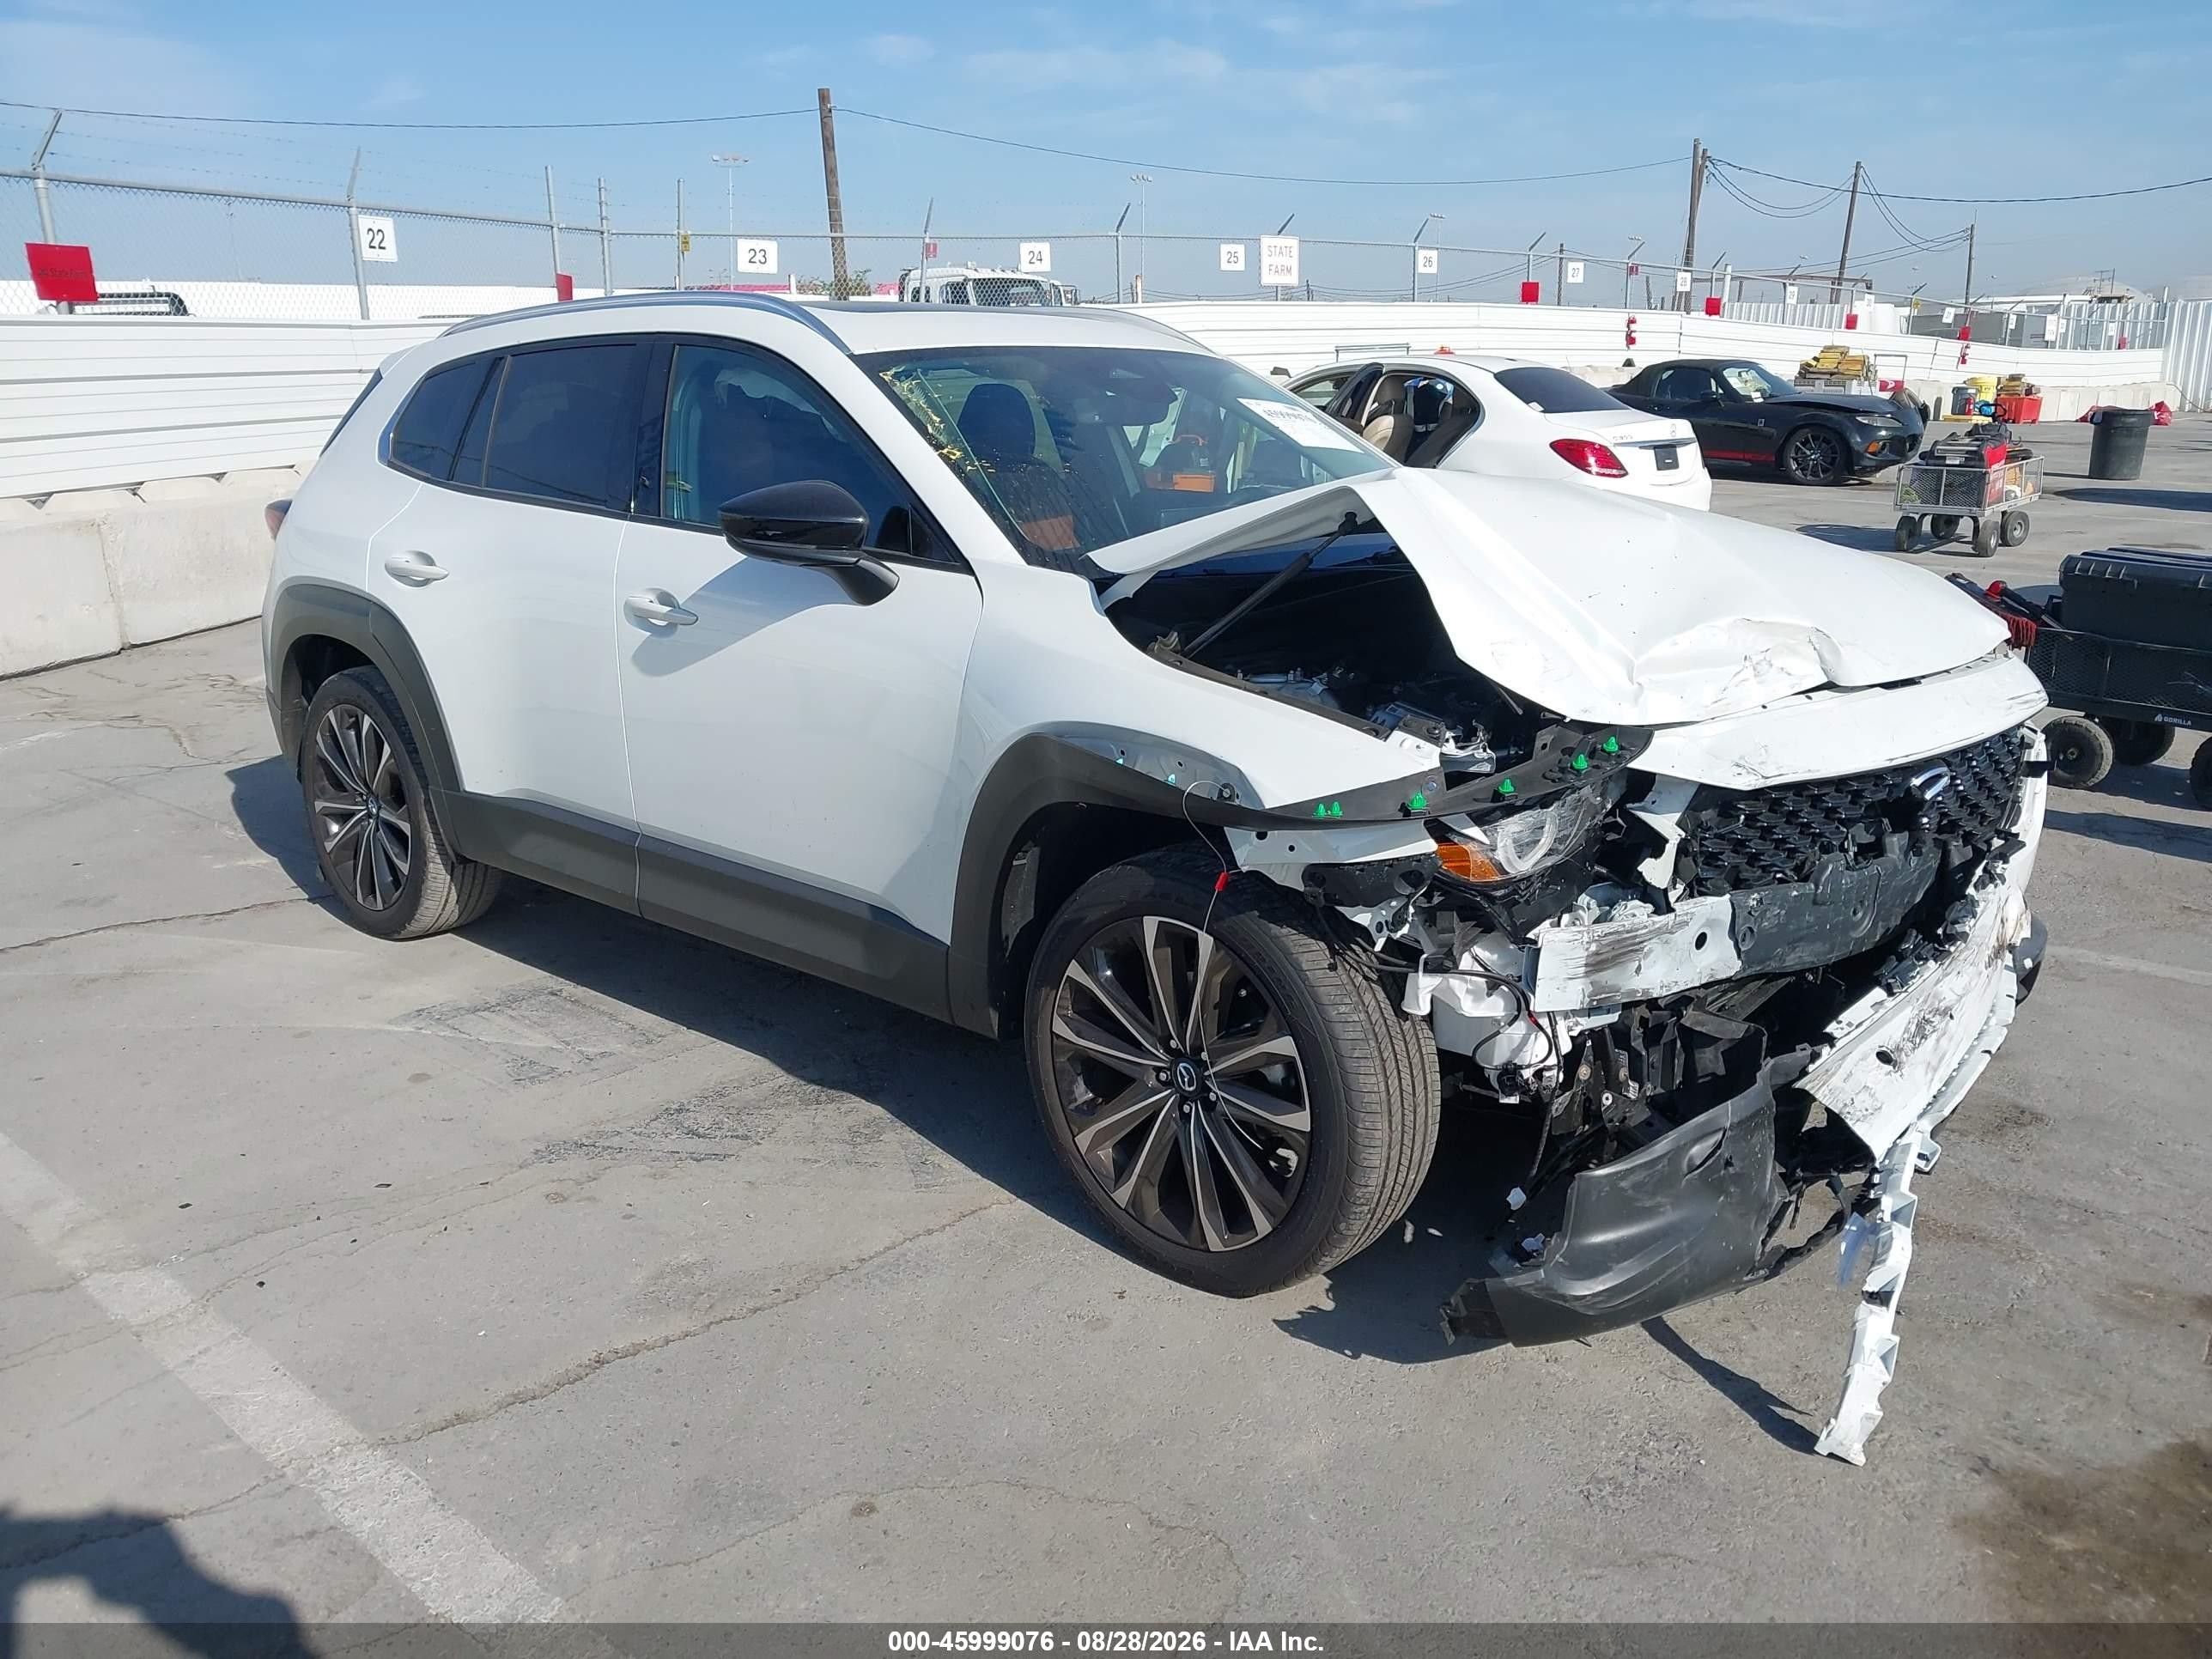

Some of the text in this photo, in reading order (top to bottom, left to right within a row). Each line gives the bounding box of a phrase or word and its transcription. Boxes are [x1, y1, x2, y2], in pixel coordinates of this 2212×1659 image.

[367, 228, 386, 250] 22
[748, 248, 768, 265] 23
[1028, 250, 1043, 264] 24
[1226, 251, 1239, 264] 25
[1267, 245, 1293, 258] STATE
[1423, 256, 1433, 268] 26
[1268, 264, 1292, 276] FARM
[2164, 716, 2191, 726] GORILLA
